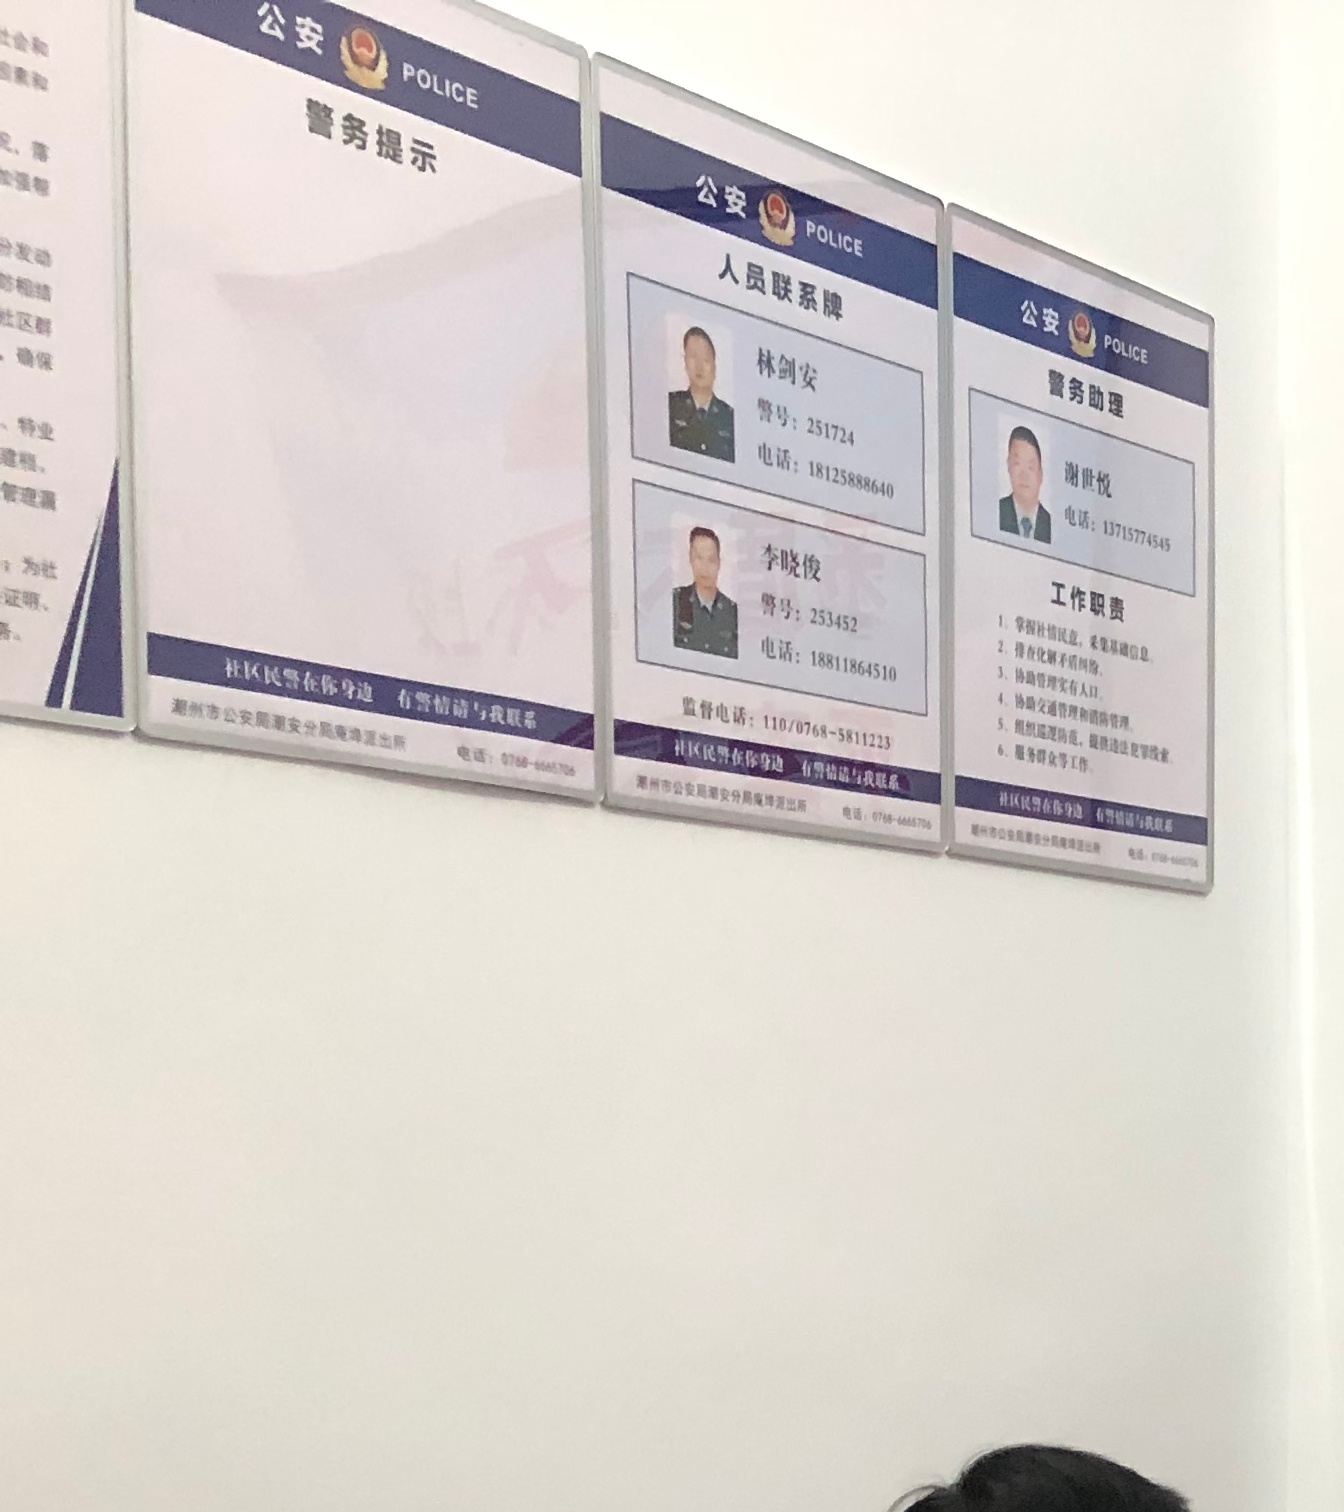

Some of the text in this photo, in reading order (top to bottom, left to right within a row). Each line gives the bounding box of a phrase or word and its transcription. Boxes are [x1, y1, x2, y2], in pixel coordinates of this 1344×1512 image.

[257, 2, 478, 109] 公安 POLICE
[306, 97, 437, 174] 警务提示
[695, 174, 864, 258] 公安 POLICE
[718, 252, 843, 321] 人员联系牌
[1020, 299, 1149, 365] 公安 POLICE
[757, 347, 818, 392] 林剑安
[1048, 368, 1124, 420] 警务助理
[1064, 460, 1112, 499] 谢世悦
[761, 543, 822, 583] 李晓俊
[1050, 581, 1125, 623] 工作职责
[225, 656, 537, 730] 社区民警在你身边 有警情请与我联系
[674, 739, 899, 791] 社区民警在你身边 有警情请与我联系
